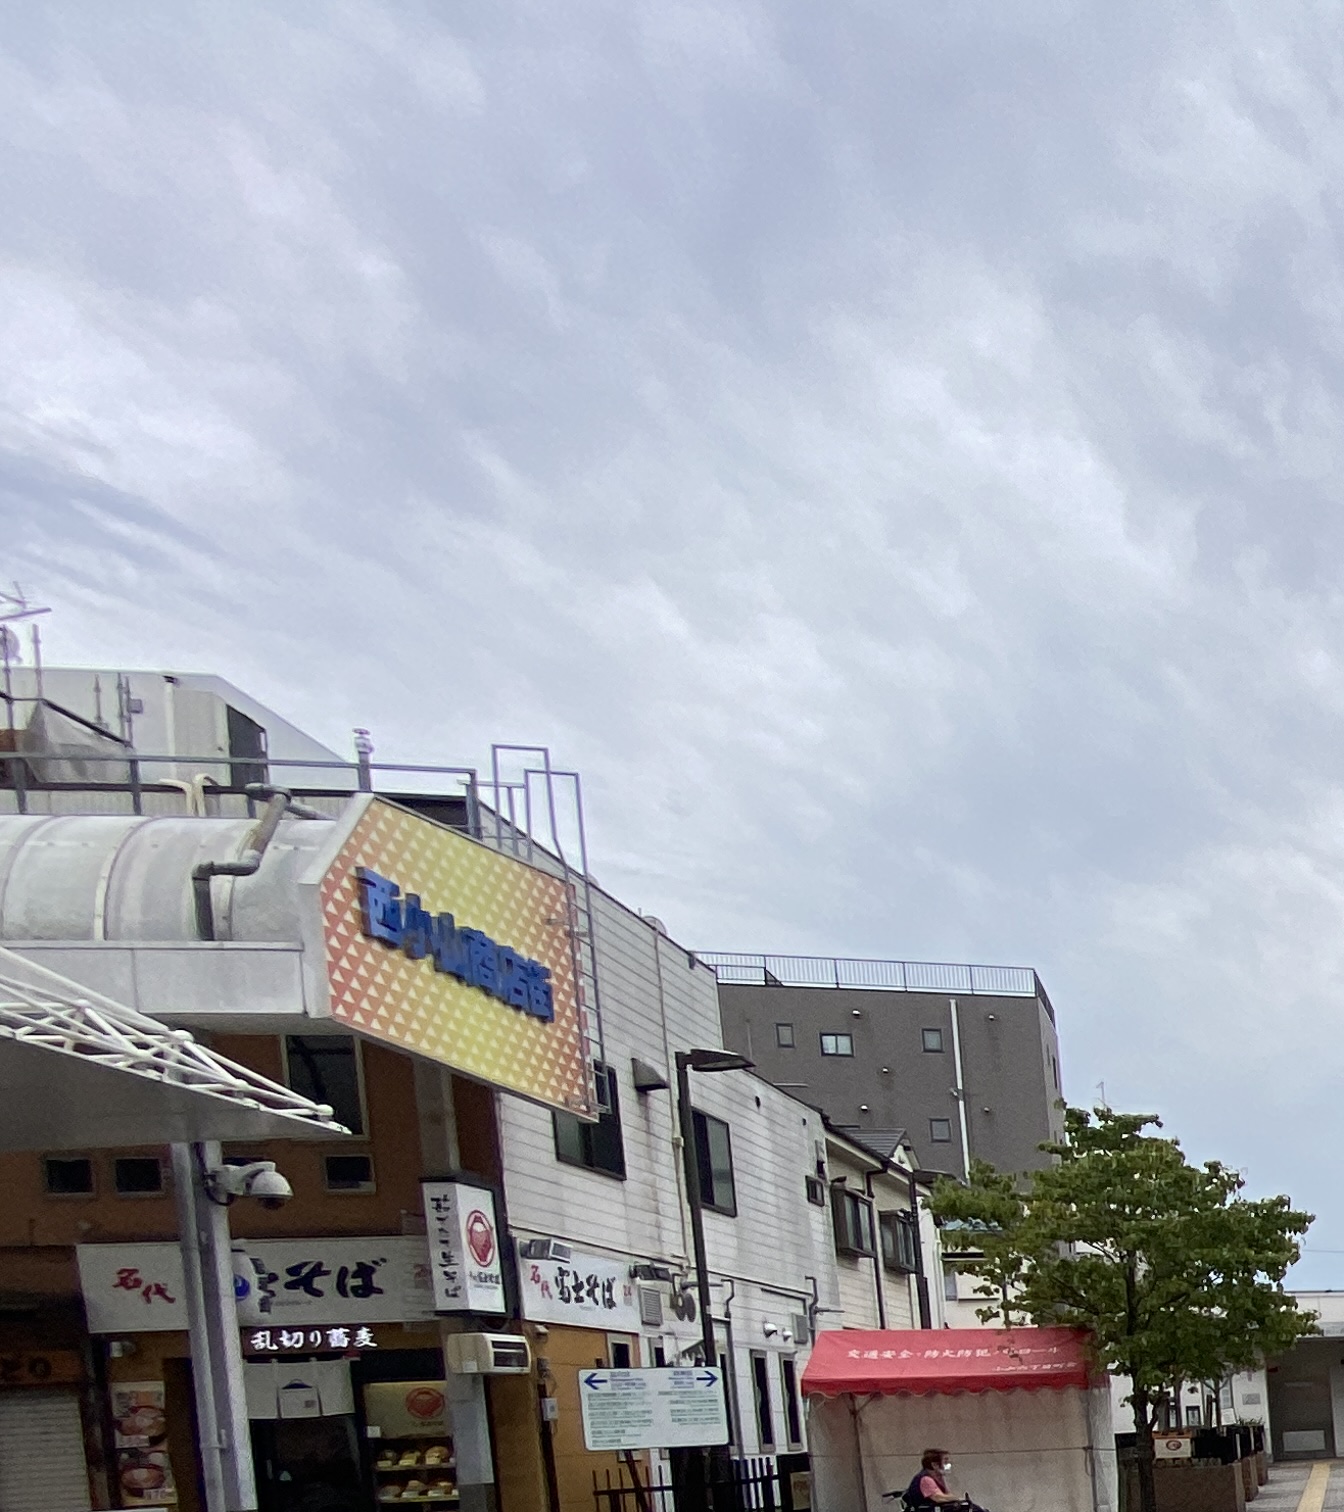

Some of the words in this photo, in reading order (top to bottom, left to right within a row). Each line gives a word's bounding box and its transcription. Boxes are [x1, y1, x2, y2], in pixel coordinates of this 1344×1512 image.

[555, 1266, 618, 1309] 富士そば
[250, 1327, 378, 1350] 乱切り蕎麦
